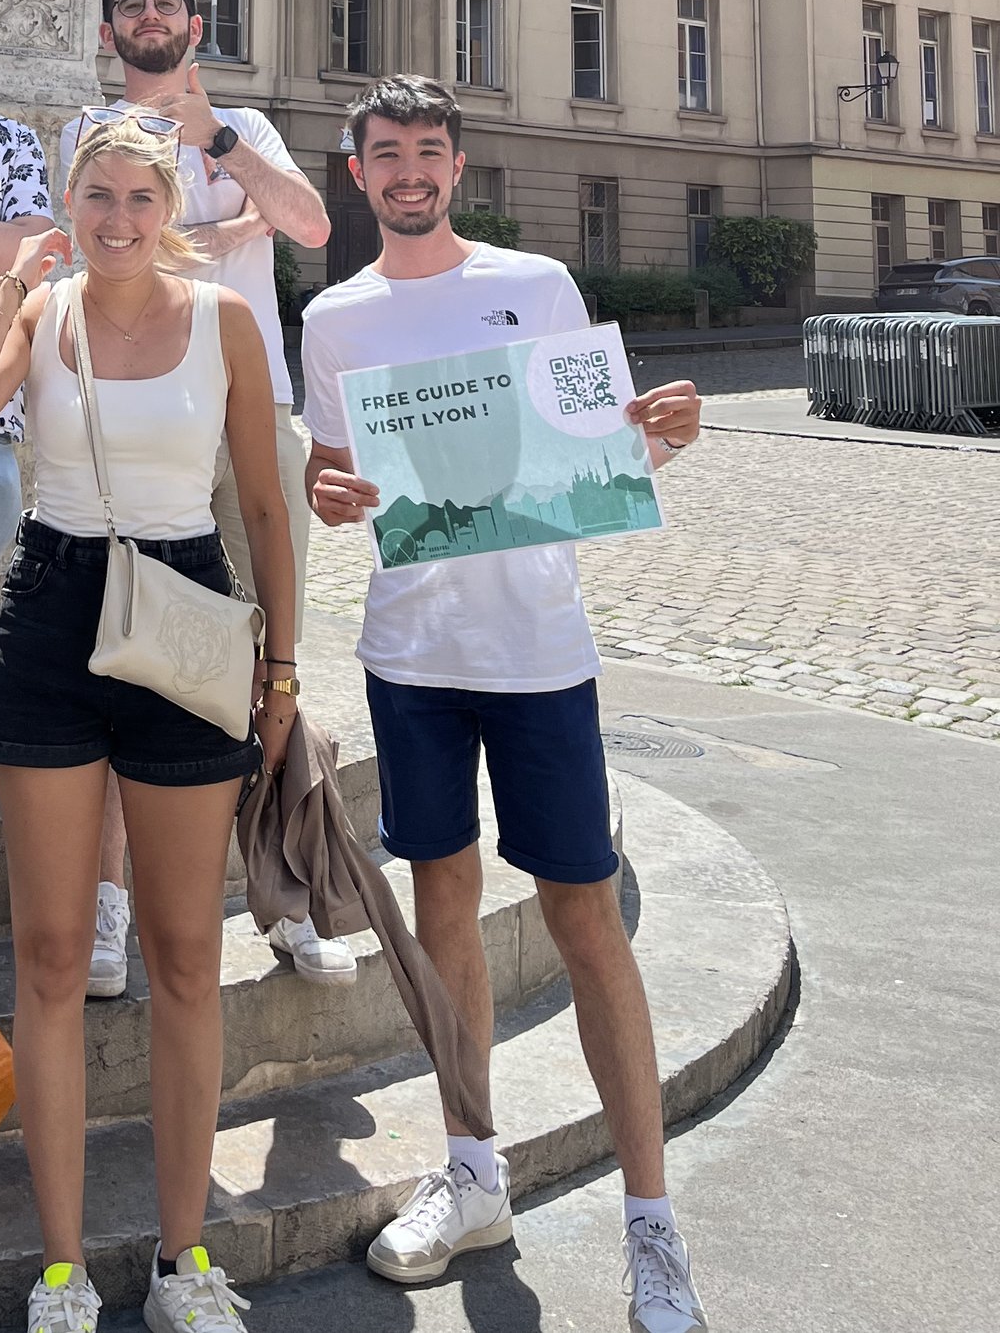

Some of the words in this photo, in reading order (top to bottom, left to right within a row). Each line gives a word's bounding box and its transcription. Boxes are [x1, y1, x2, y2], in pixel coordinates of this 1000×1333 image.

[361, 392, 410, 411] FREE
[416, 379, 479, 402] GUIDE
[483, 374, 512, 390] TO
[365, 416, 415, 435] VISIT
[421, 405, 477, 427] LYON
[482, 403, 489, 416] !
